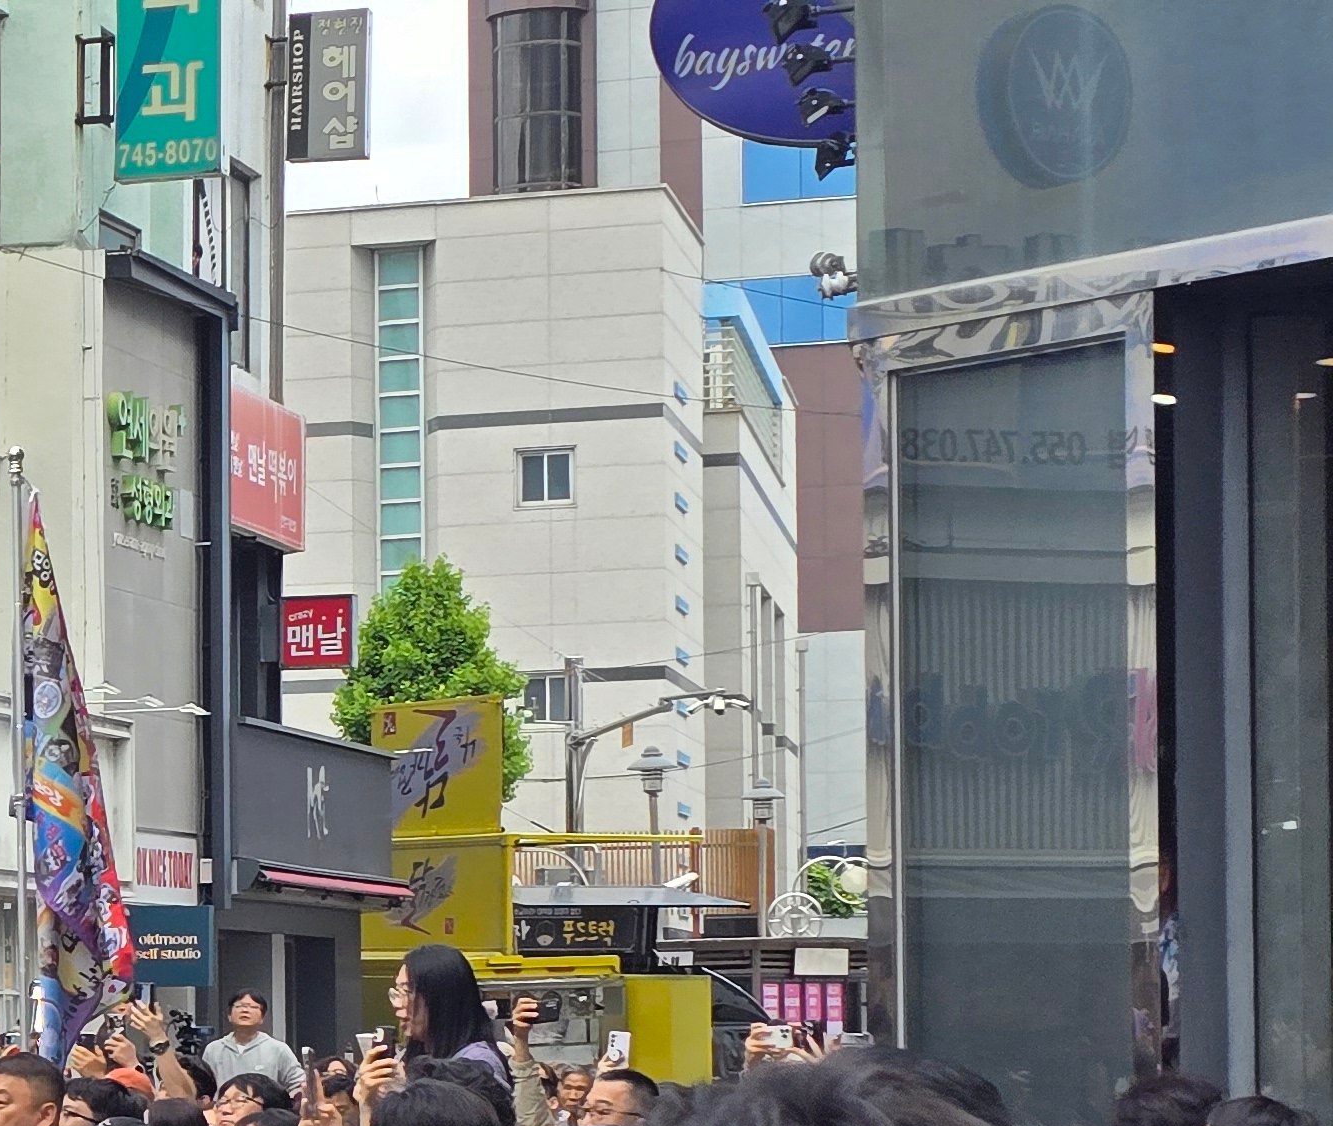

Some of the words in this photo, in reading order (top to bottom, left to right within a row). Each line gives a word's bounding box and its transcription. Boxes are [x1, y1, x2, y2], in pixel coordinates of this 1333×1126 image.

[290, 29, 305, 131] HAIRSHOP
[322, 45, 358, 150] 헤어샵
[119, 138, 217, 169] 745-8070
[287, 614, 347, 657] 맨날
